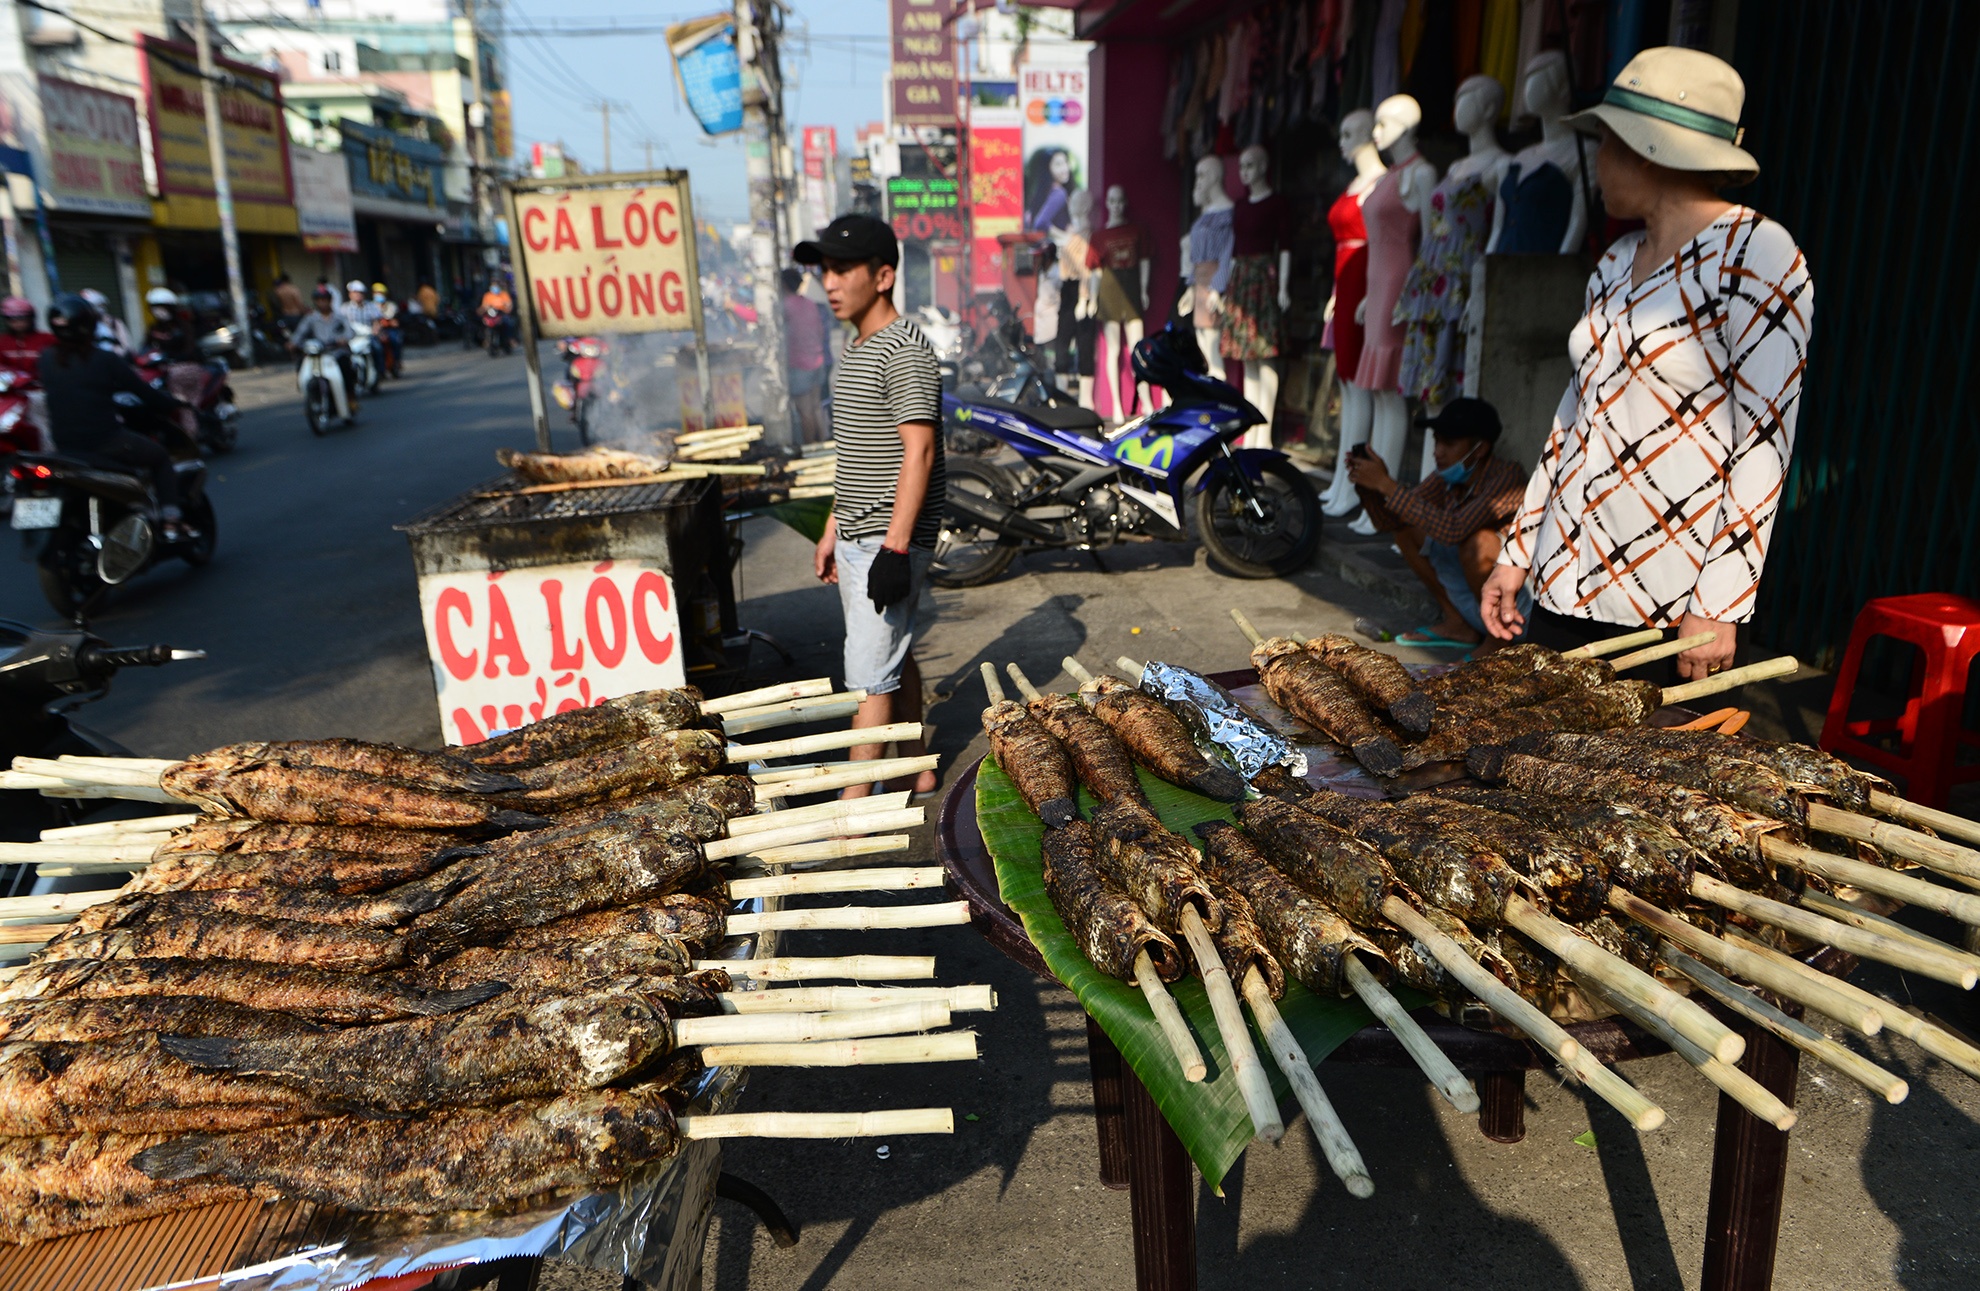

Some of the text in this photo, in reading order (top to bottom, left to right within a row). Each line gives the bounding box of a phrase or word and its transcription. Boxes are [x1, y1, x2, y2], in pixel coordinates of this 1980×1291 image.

[1025, 70, 1084, 93] IELTS
[524, 192, 581, 252] CÁ
[892, 212, 962, 240] 50%
[535, 254, 686, 322] NƯỚNG
[435, 569, 531, 682] CÁ
